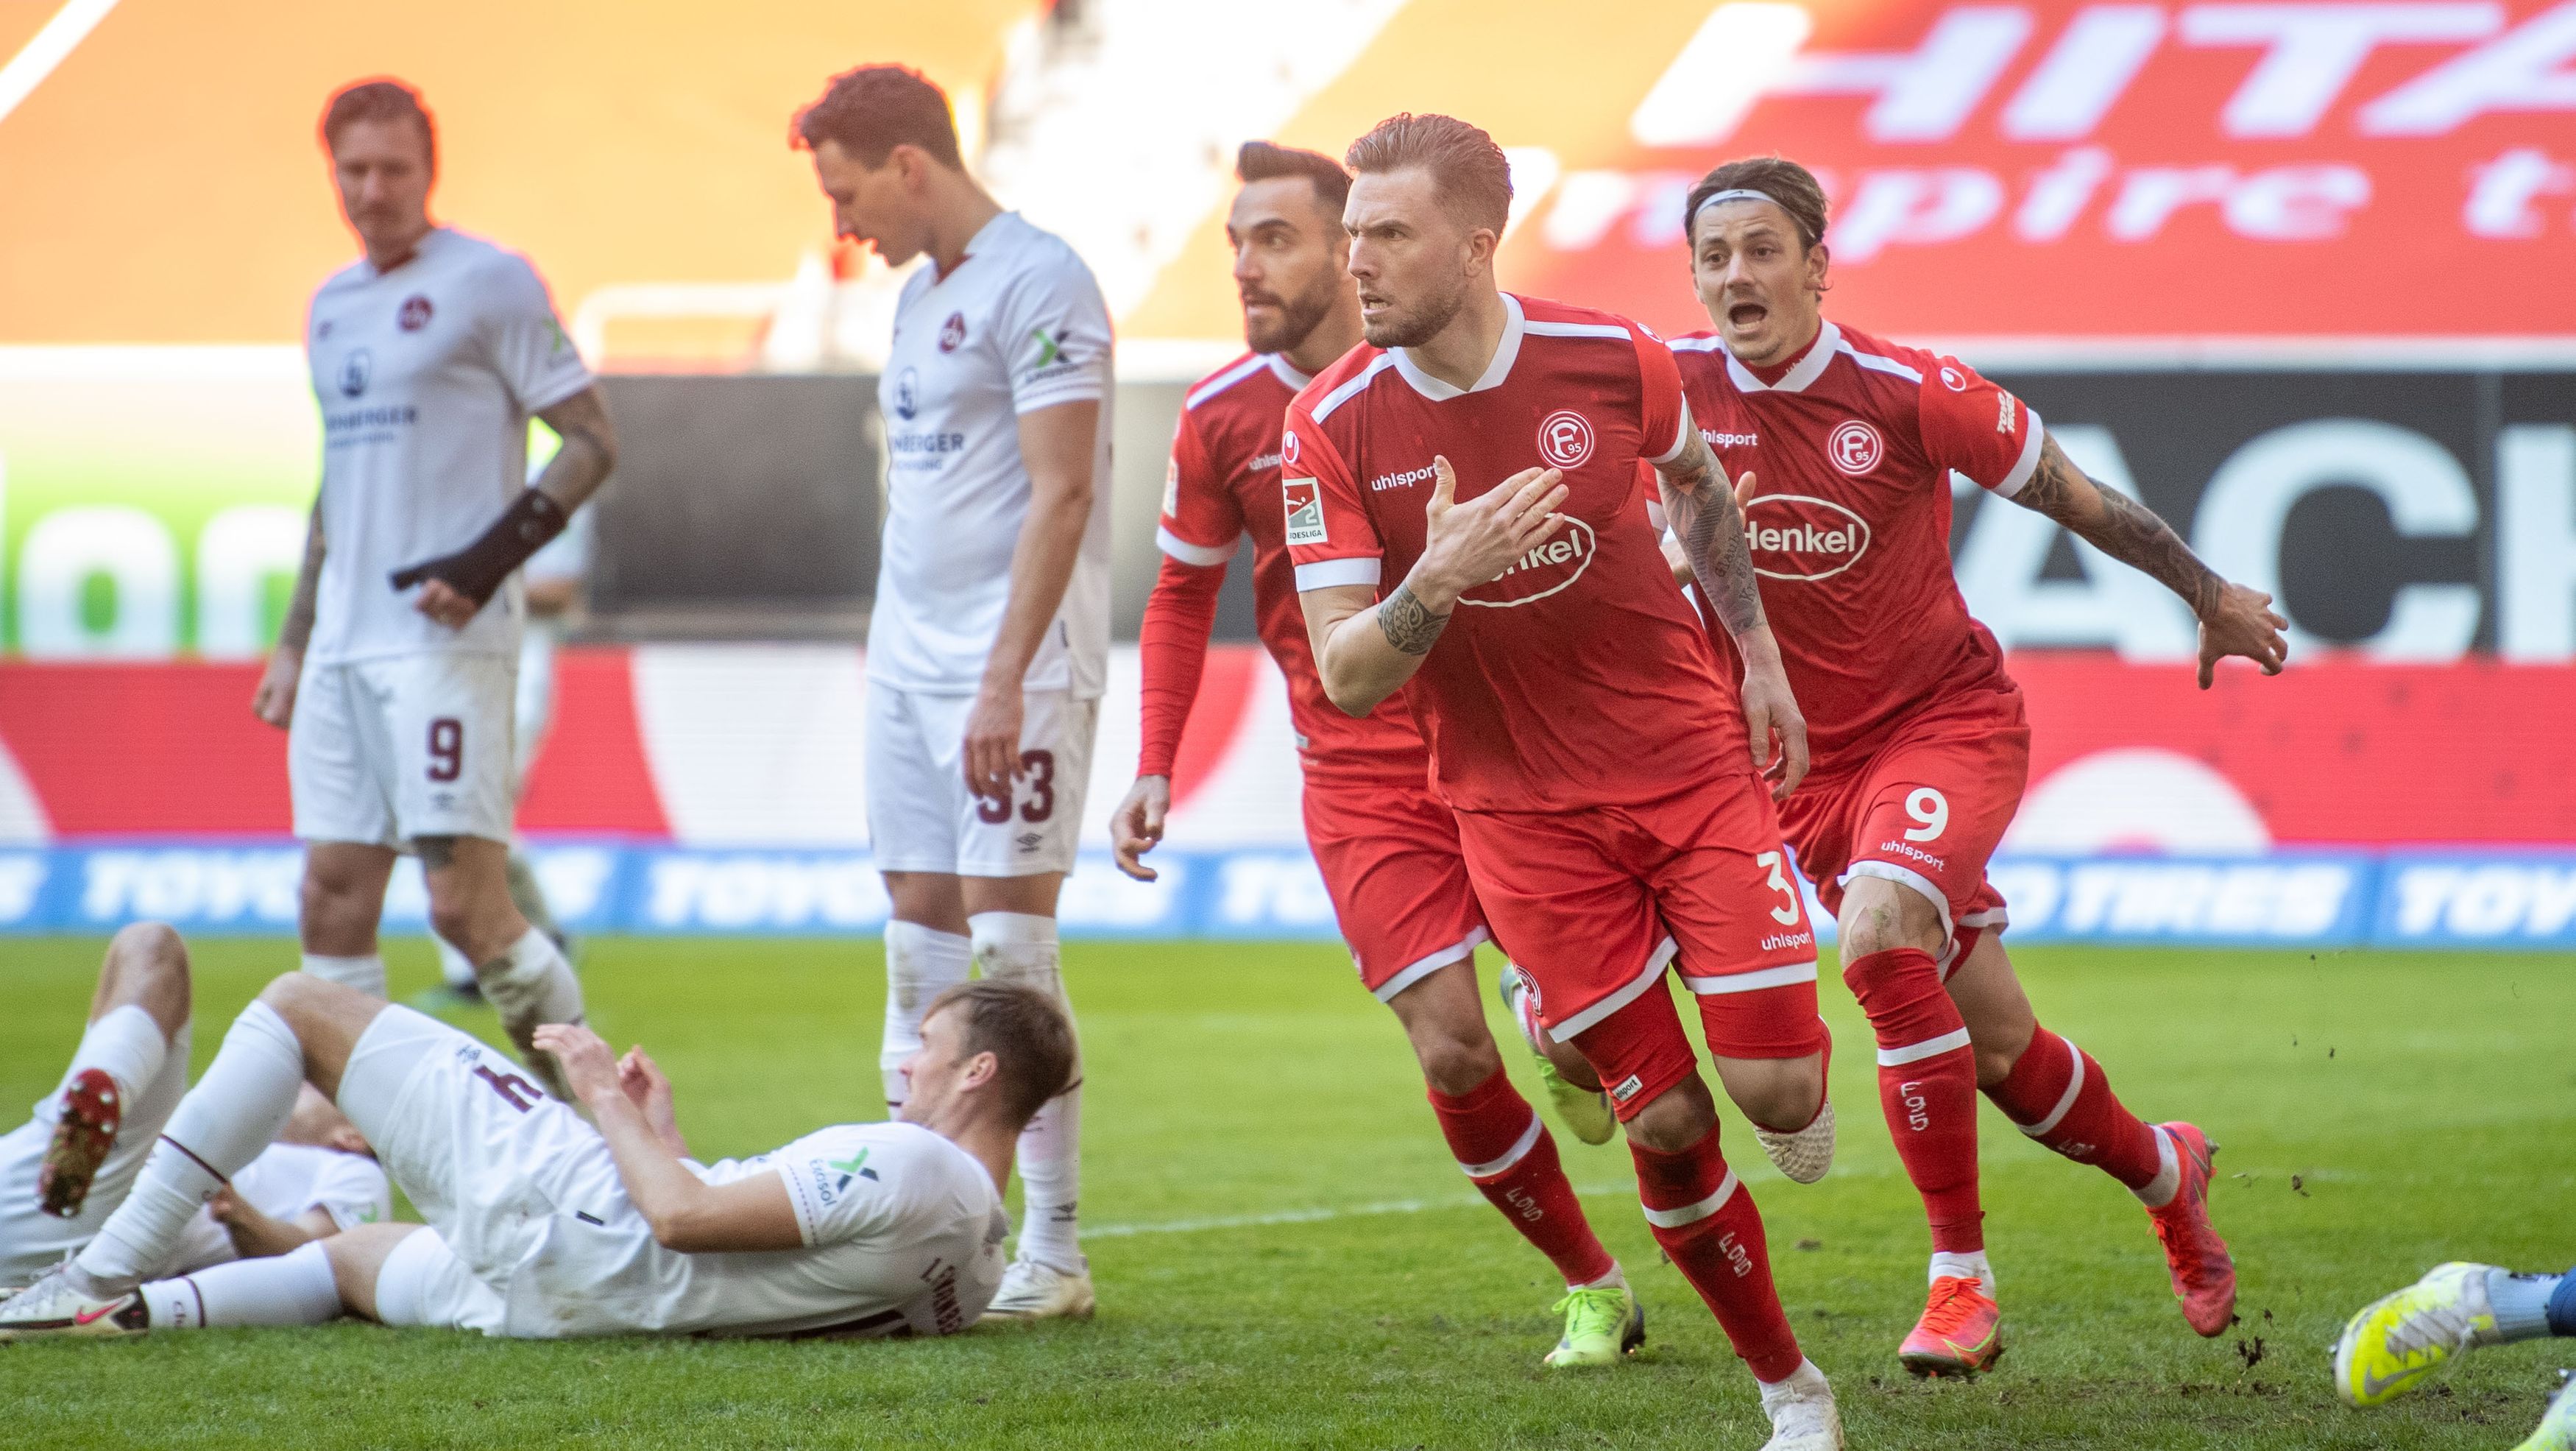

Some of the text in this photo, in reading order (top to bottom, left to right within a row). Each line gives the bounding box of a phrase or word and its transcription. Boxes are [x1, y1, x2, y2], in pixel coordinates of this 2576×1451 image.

[1568, 442, 1582, 454] 95
[1698, 428, 1758, 448] hlsport
[1855, 451, 1869, 461] 95
[428, 718, 463, 782] 9
[1903, 787, 1949, 842] 9
[1880, 840, 1945, 872] uhlsport
[1757, 851, 1799, 926] 3
[472, 1065, 544, 1114] 4
